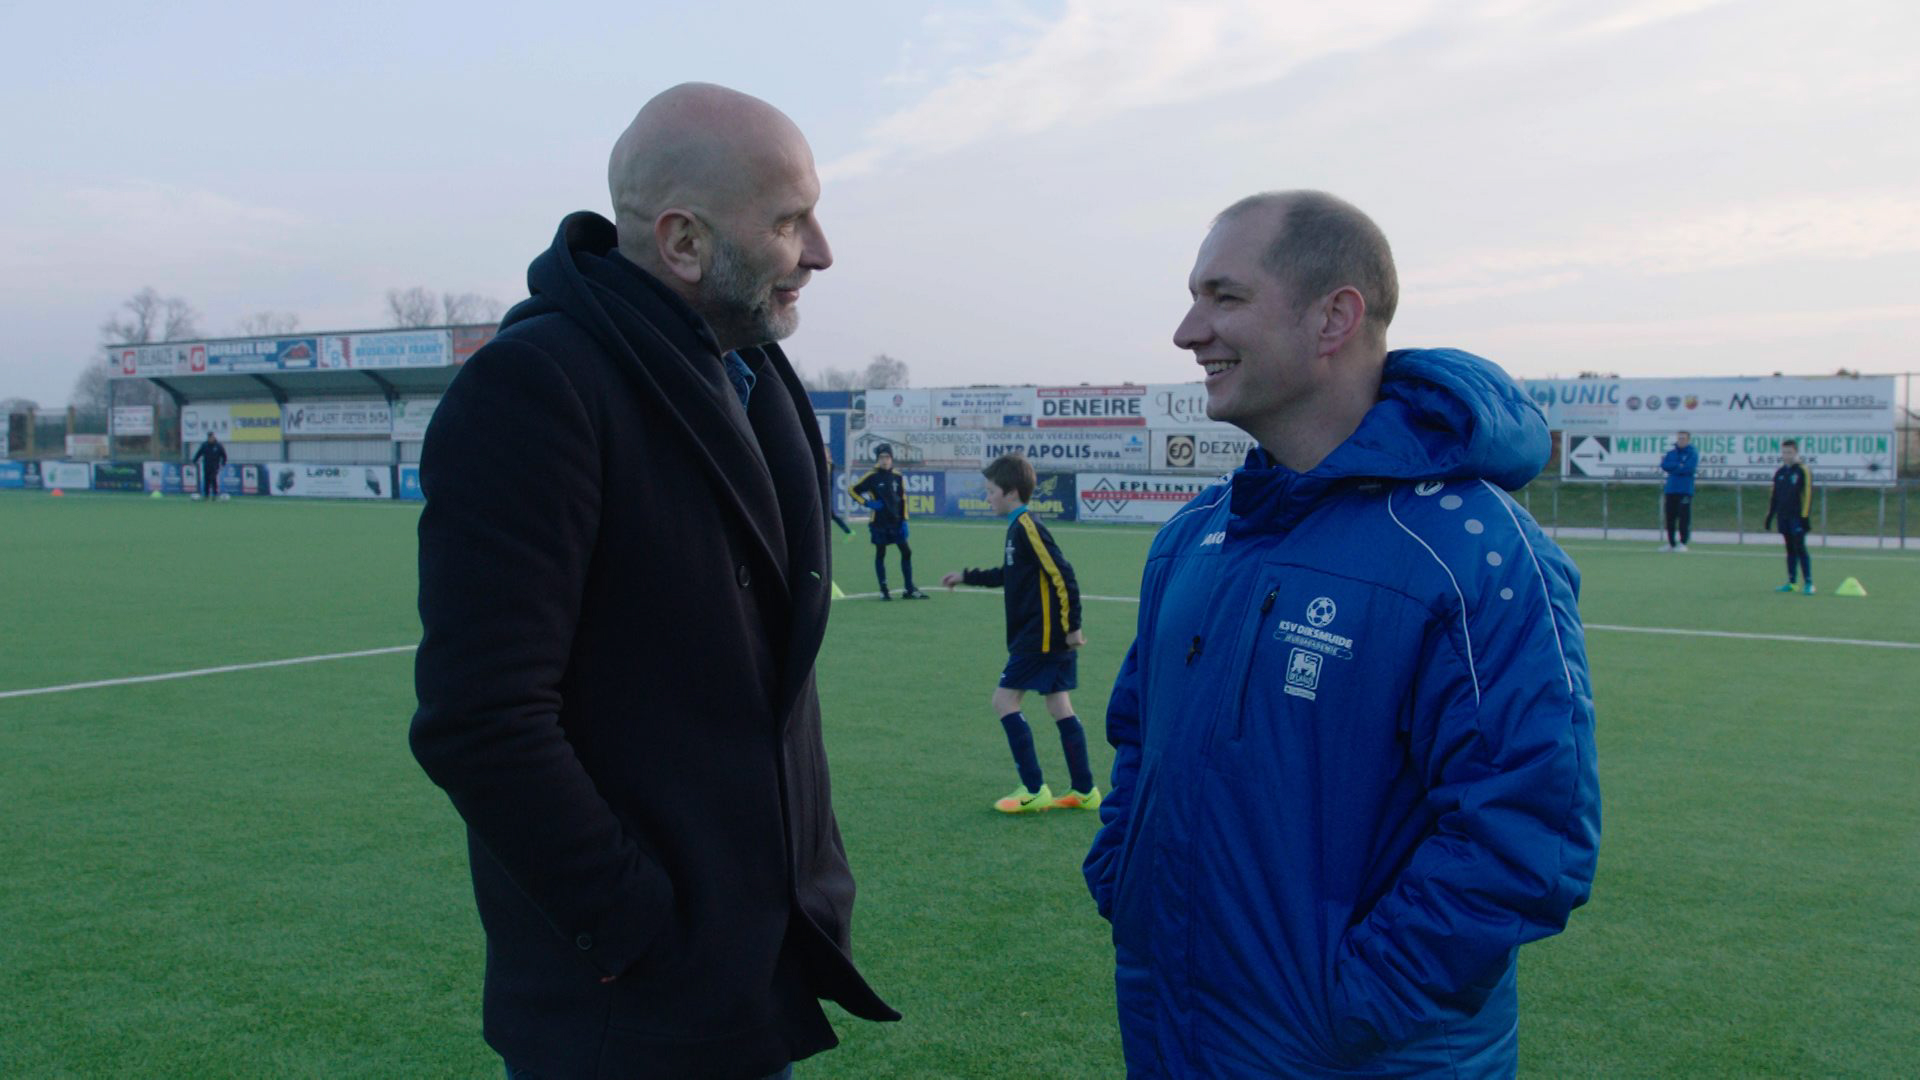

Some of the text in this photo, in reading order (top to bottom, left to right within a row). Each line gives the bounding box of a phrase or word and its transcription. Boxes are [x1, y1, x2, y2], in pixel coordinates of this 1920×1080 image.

[1042, 398, 1142, 416] DENEIRE
[1155, 390, 1204, 424] Lett
[1028, 432, 1044, 440] UW
[1616, 434, 1888, 454] WHITE OUSE CONTRUCTION
[986, 445, 1091, 458] INTRAPOLIS
[1199, 440, 1257, 455] DEZWA
[1154, 483, 1203, 492] TENTE
[1279, 620, 1299, 632] KSV
[1296, 624, 1354, 649] DIKSMUIDE
